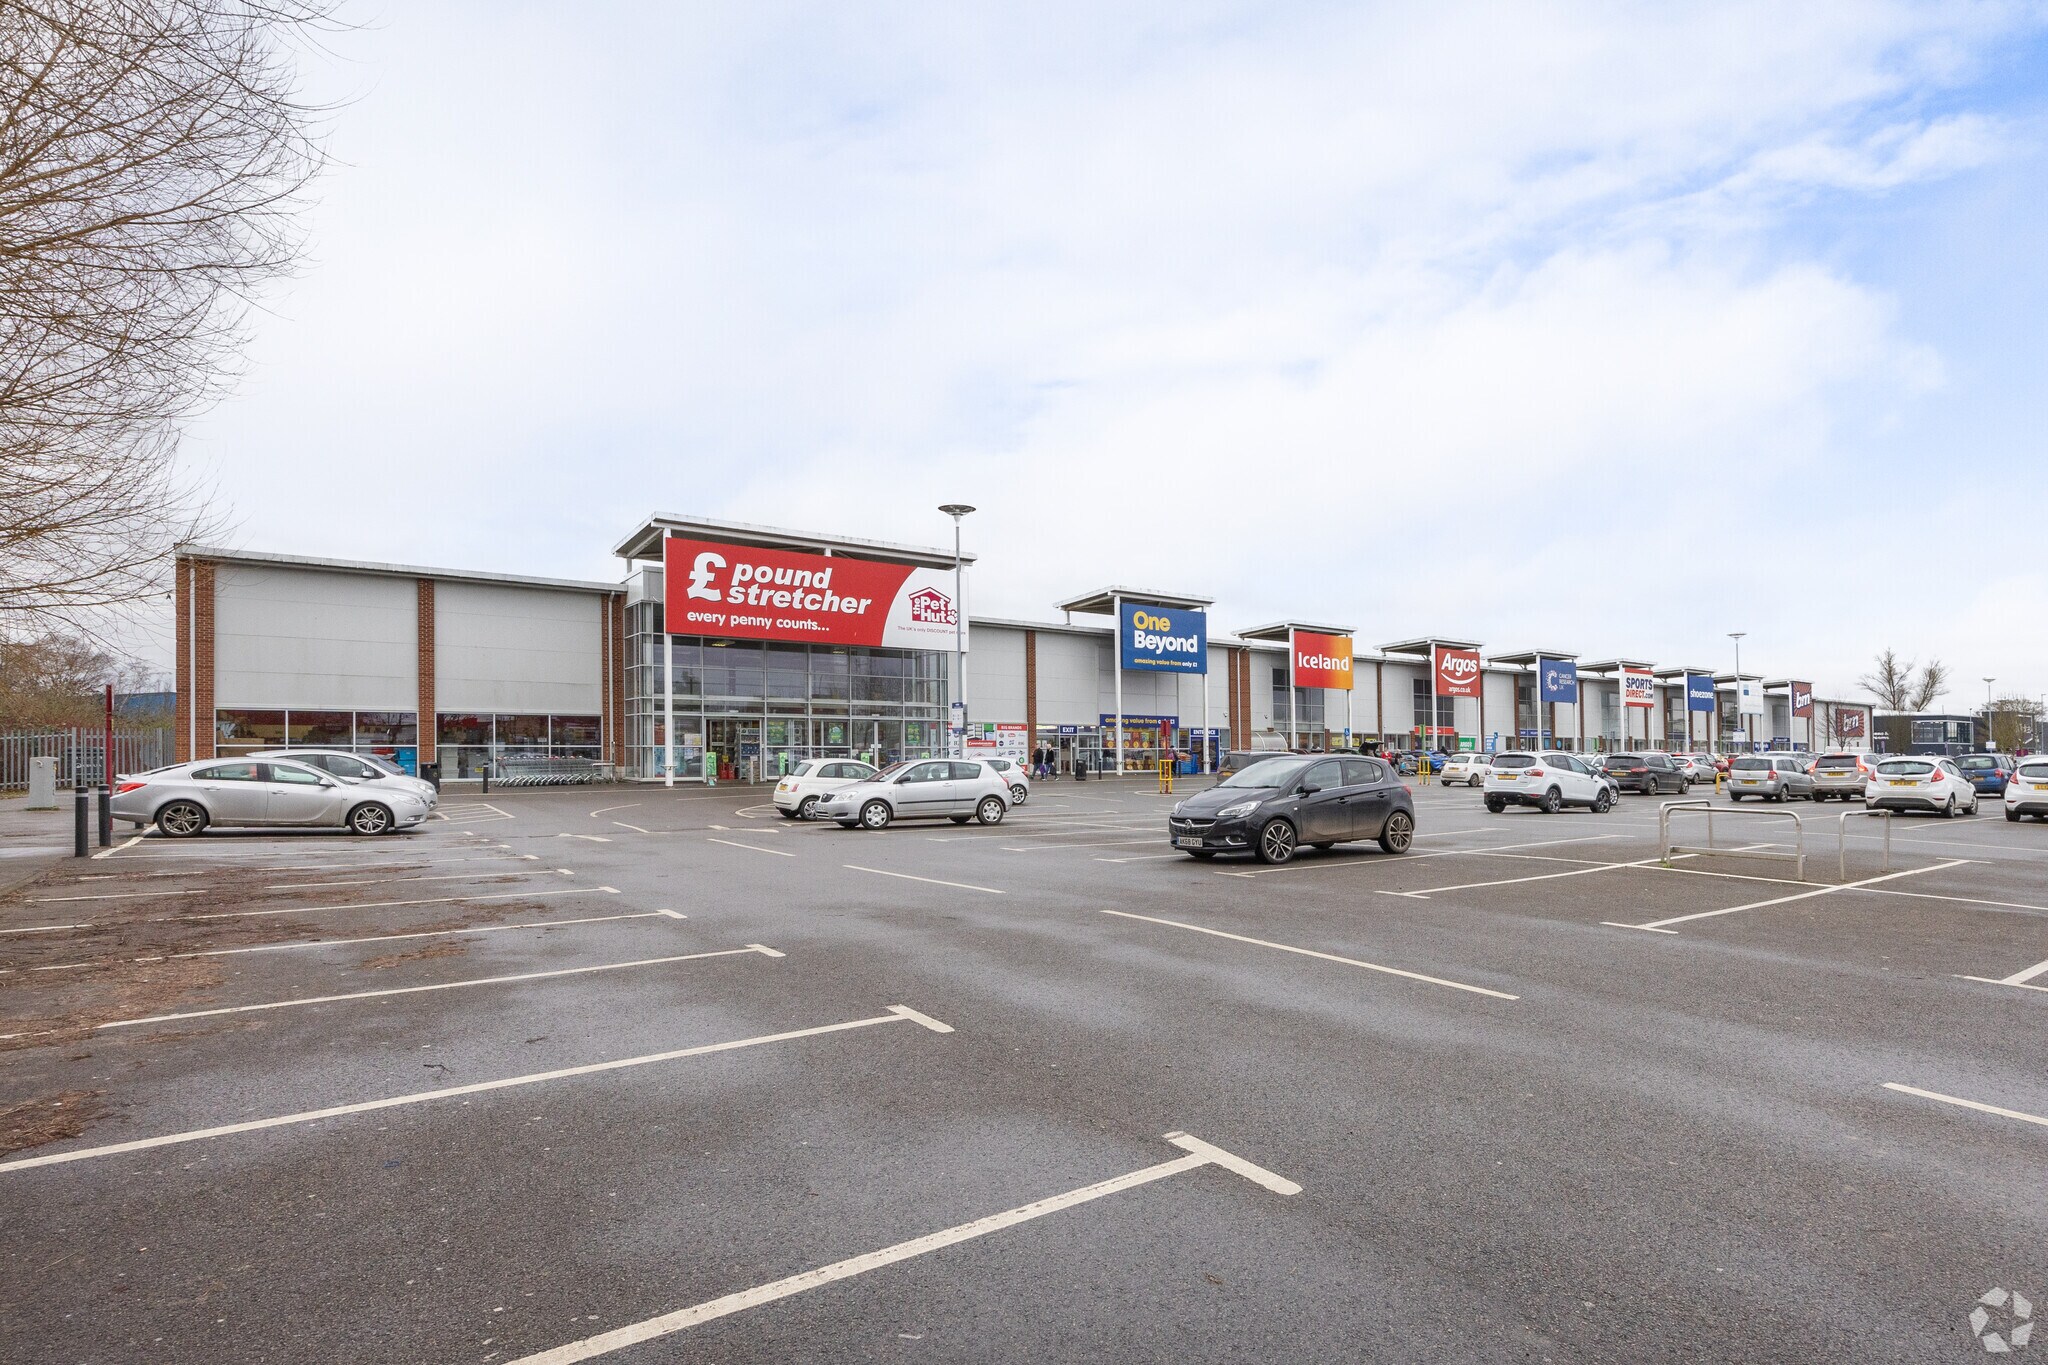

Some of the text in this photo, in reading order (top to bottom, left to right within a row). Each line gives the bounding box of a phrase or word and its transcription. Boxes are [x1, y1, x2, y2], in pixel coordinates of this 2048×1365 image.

[686, 551, 727, 602] £
[730, 563, 833, 590] pound
[726, 583, 872, 615] stretcher
[912, 597, 920, 615] the
[920, 596, 946, 611] Pet
[686, 611, 726, 627] every
[730, 615, 773, 630] penny
[920, 608, 947, 624] Hut
[1133, 610, 1171, 632] One
[1134, 629, 1198, 655] Beyond
[1134, 658, 1156, 666] amazing
[1298, 651, 1350, 672] Iceland
[1441, 652, 1478, 677] Argos
[1448, 686, 1472, 694] argos.co.uk
[1558, 678, 1575, 686] RESEARCH
[1625, 676, 1654, 691] SPORTS
[1690, 688, 1714, 700] shoezone
[1104, 717, 1129, 725] amang
